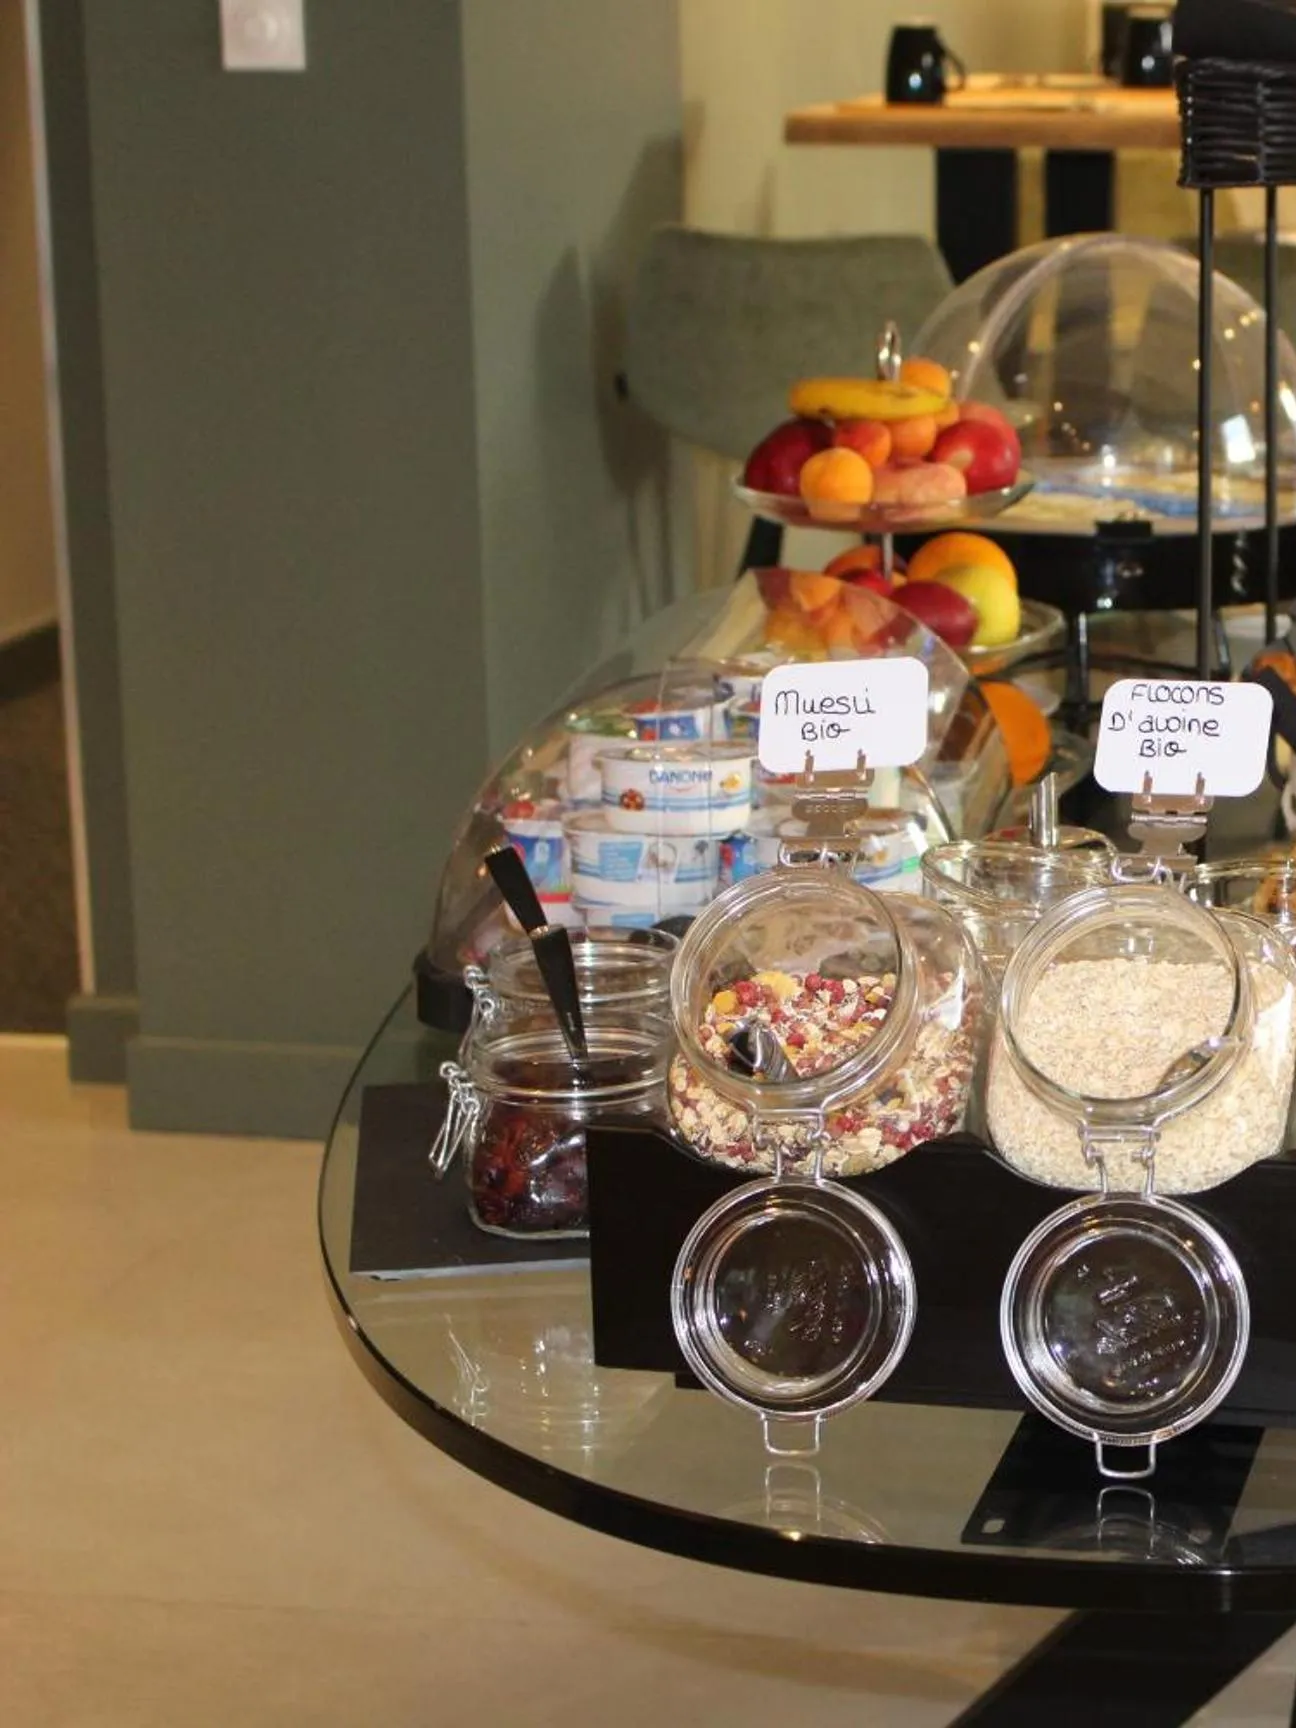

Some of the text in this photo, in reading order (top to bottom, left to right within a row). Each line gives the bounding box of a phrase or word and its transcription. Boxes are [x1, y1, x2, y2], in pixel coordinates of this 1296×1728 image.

[775, 688, 876, 715] Muesli
[1131, 684, 1225, 705] Flocons
[801, 721, 851, 741] Bio
[1139, 738, 1187, 758] Bio
